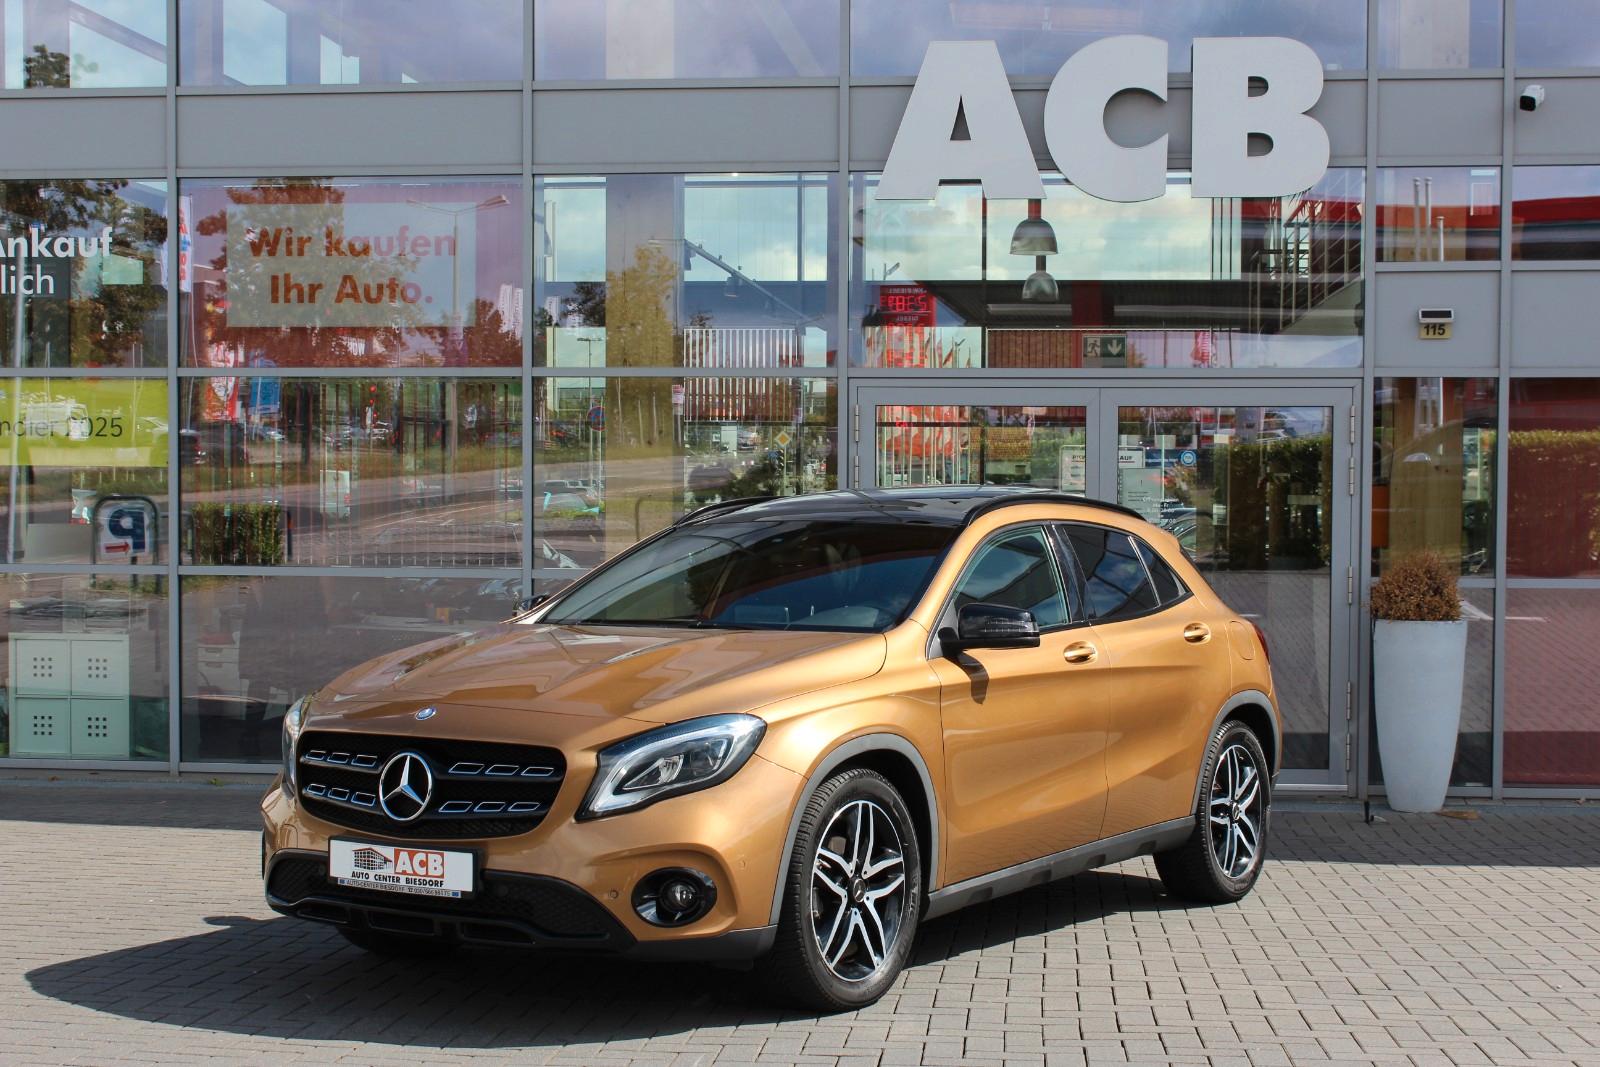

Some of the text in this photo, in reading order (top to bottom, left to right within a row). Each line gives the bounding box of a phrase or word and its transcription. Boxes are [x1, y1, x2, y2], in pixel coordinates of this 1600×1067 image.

[874, 34, 1330, 203] ACB
[247, 224, 456, 257] Wir kaufen
[270, 272, 433, 304] Ihr Auto.
[1424, 323, 1446, 336] 115
[65, 416, 123, 437] 025
[395, 850, 444, 877] ACB
[352, 870, 444, 888] AUTO CENTER BIESDORF
